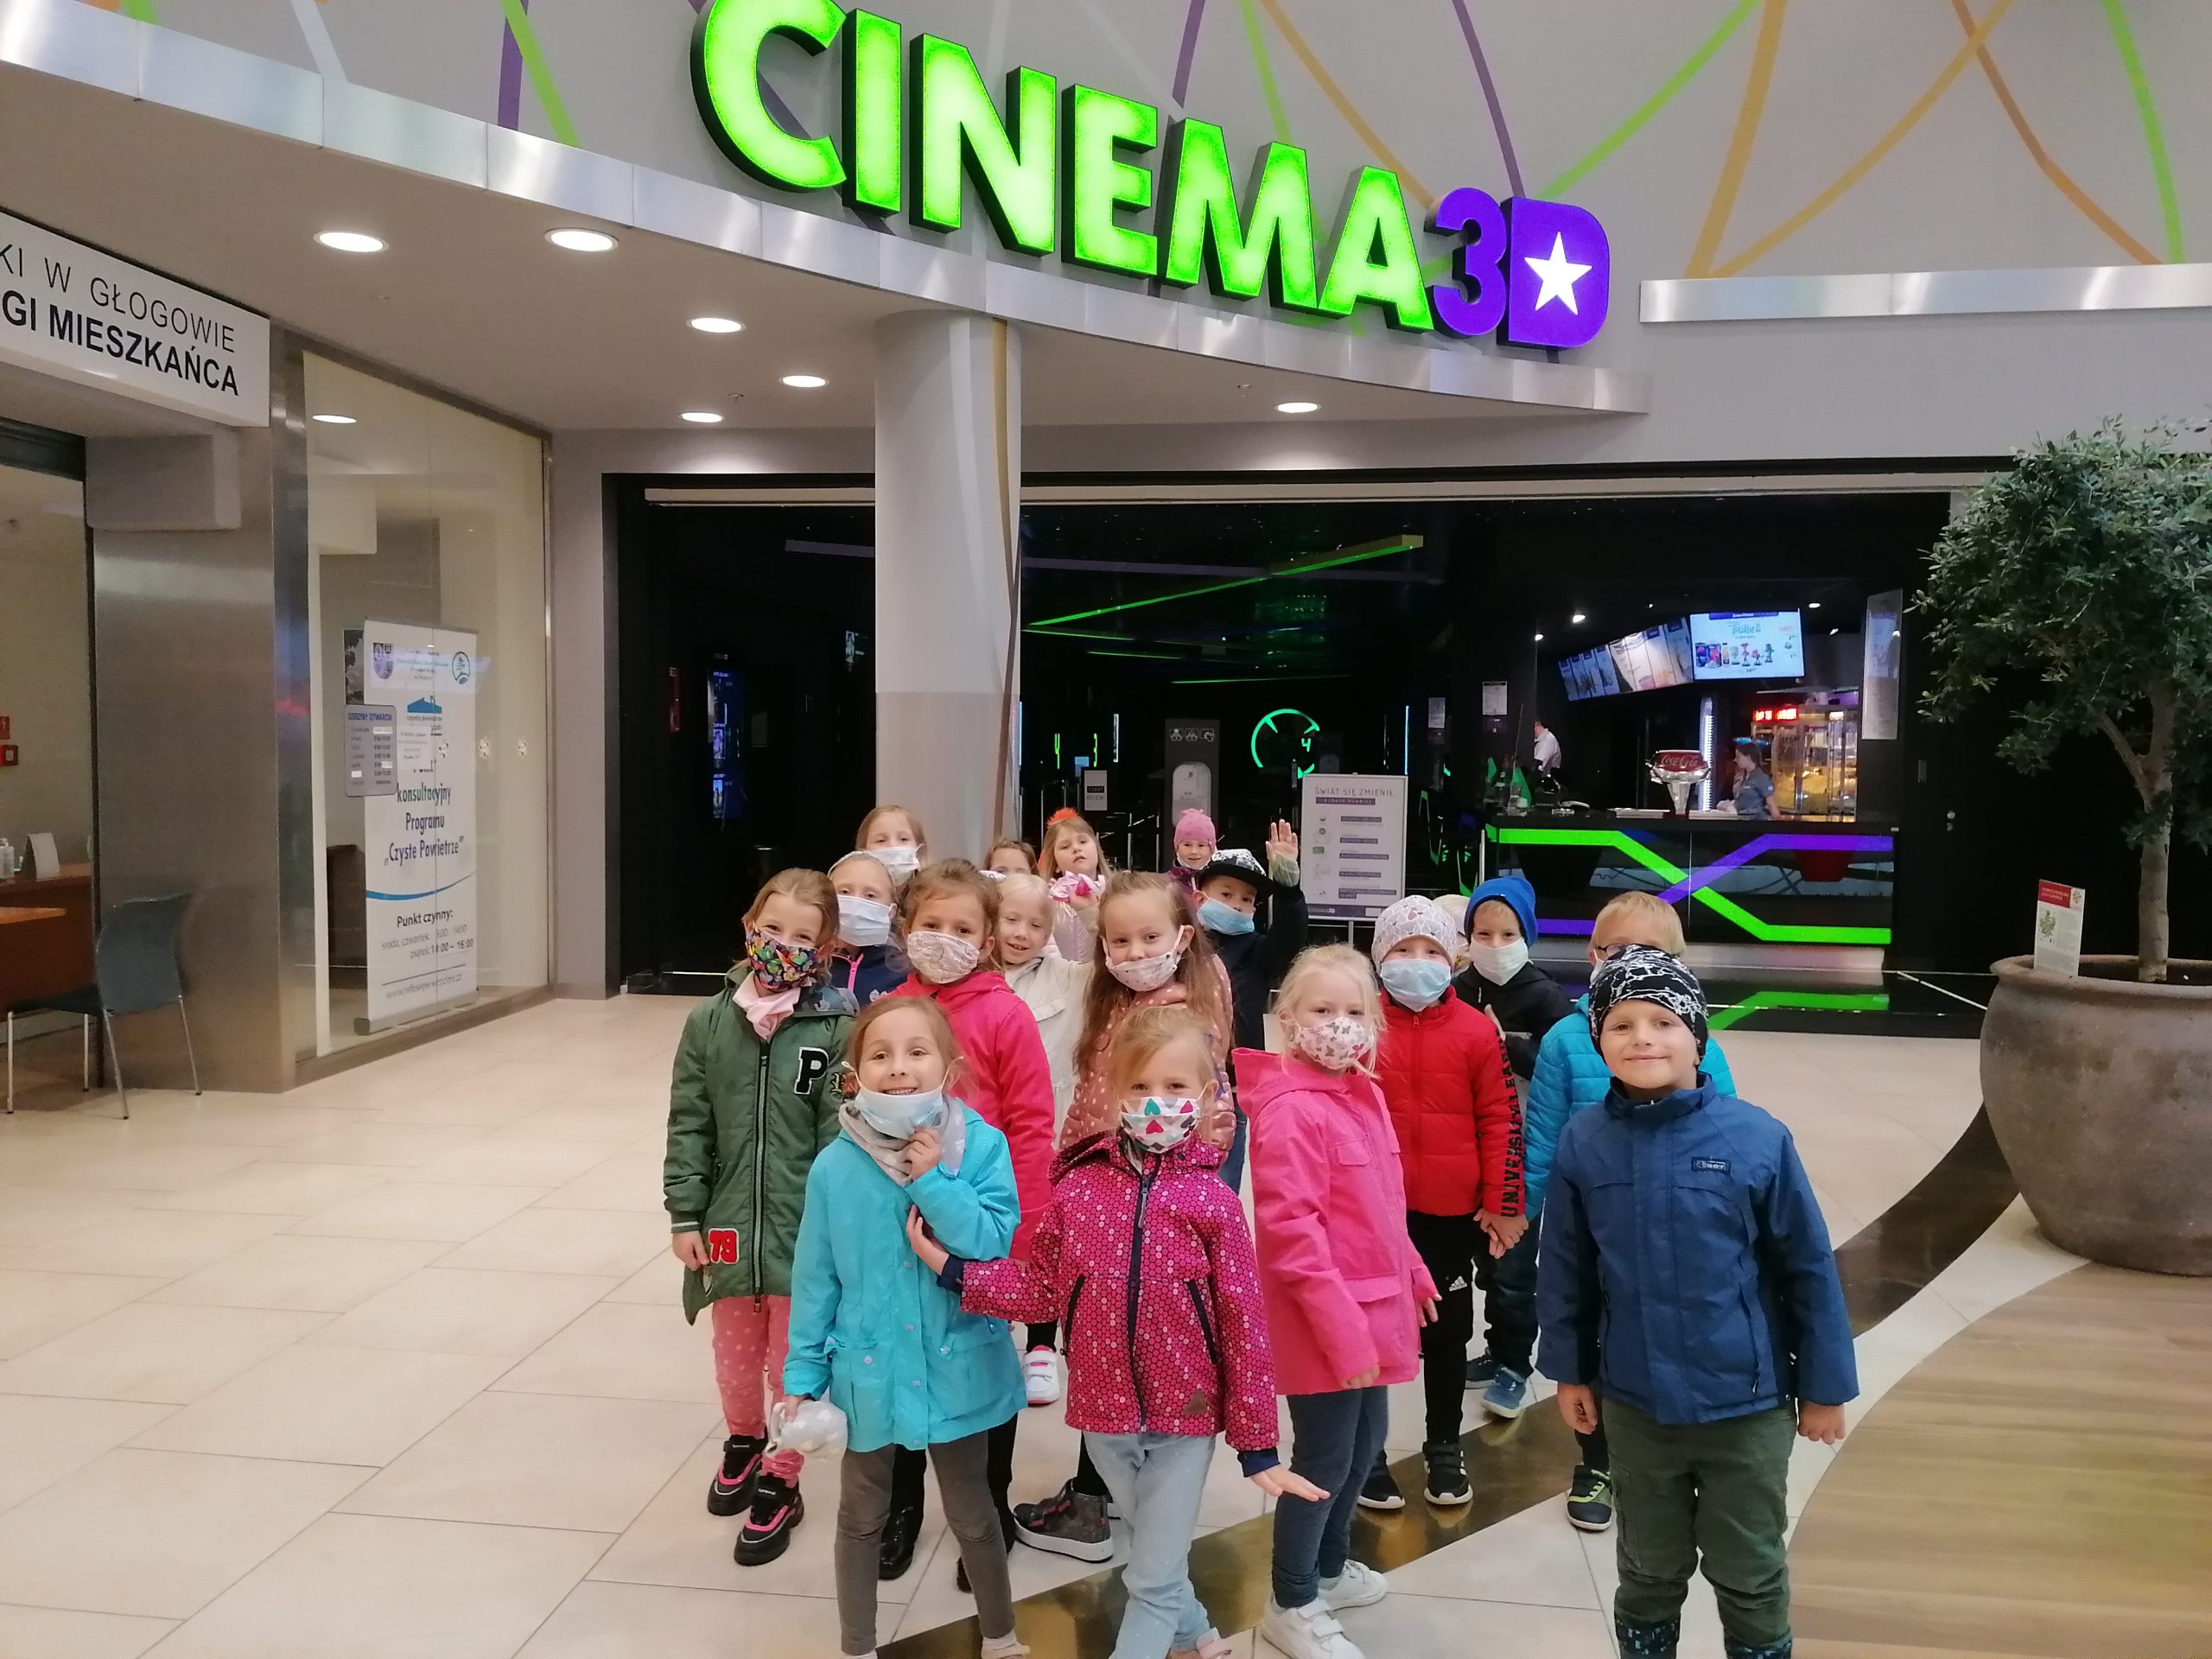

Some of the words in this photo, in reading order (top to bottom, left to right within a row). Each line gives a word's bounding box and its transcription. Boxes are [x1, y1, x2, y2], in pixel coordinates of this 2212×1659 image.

[44, 257, 71, 293] W
[90, 276, 235, 353] GŁOGOWIE
[49, 302, 239, 397] MIESZKAŃCA
[1301, 738, 1312, 753] 4
[397, 783, 452, 807] konsultacyjny
[1315, 786, 1339, 795] ŚWIAT
[1343, 788, 1357, 797] SIĘ
[1359, 788, 1395, 797] ZMIENIŁ
[406, 812, 445, 835] Programu
[397, 913, 422, 928] Punkt
[423, 910, 454, 925] czynny:
[794, 1046, 830, 1095] P
[709, 1228, 740, 1264] 79
